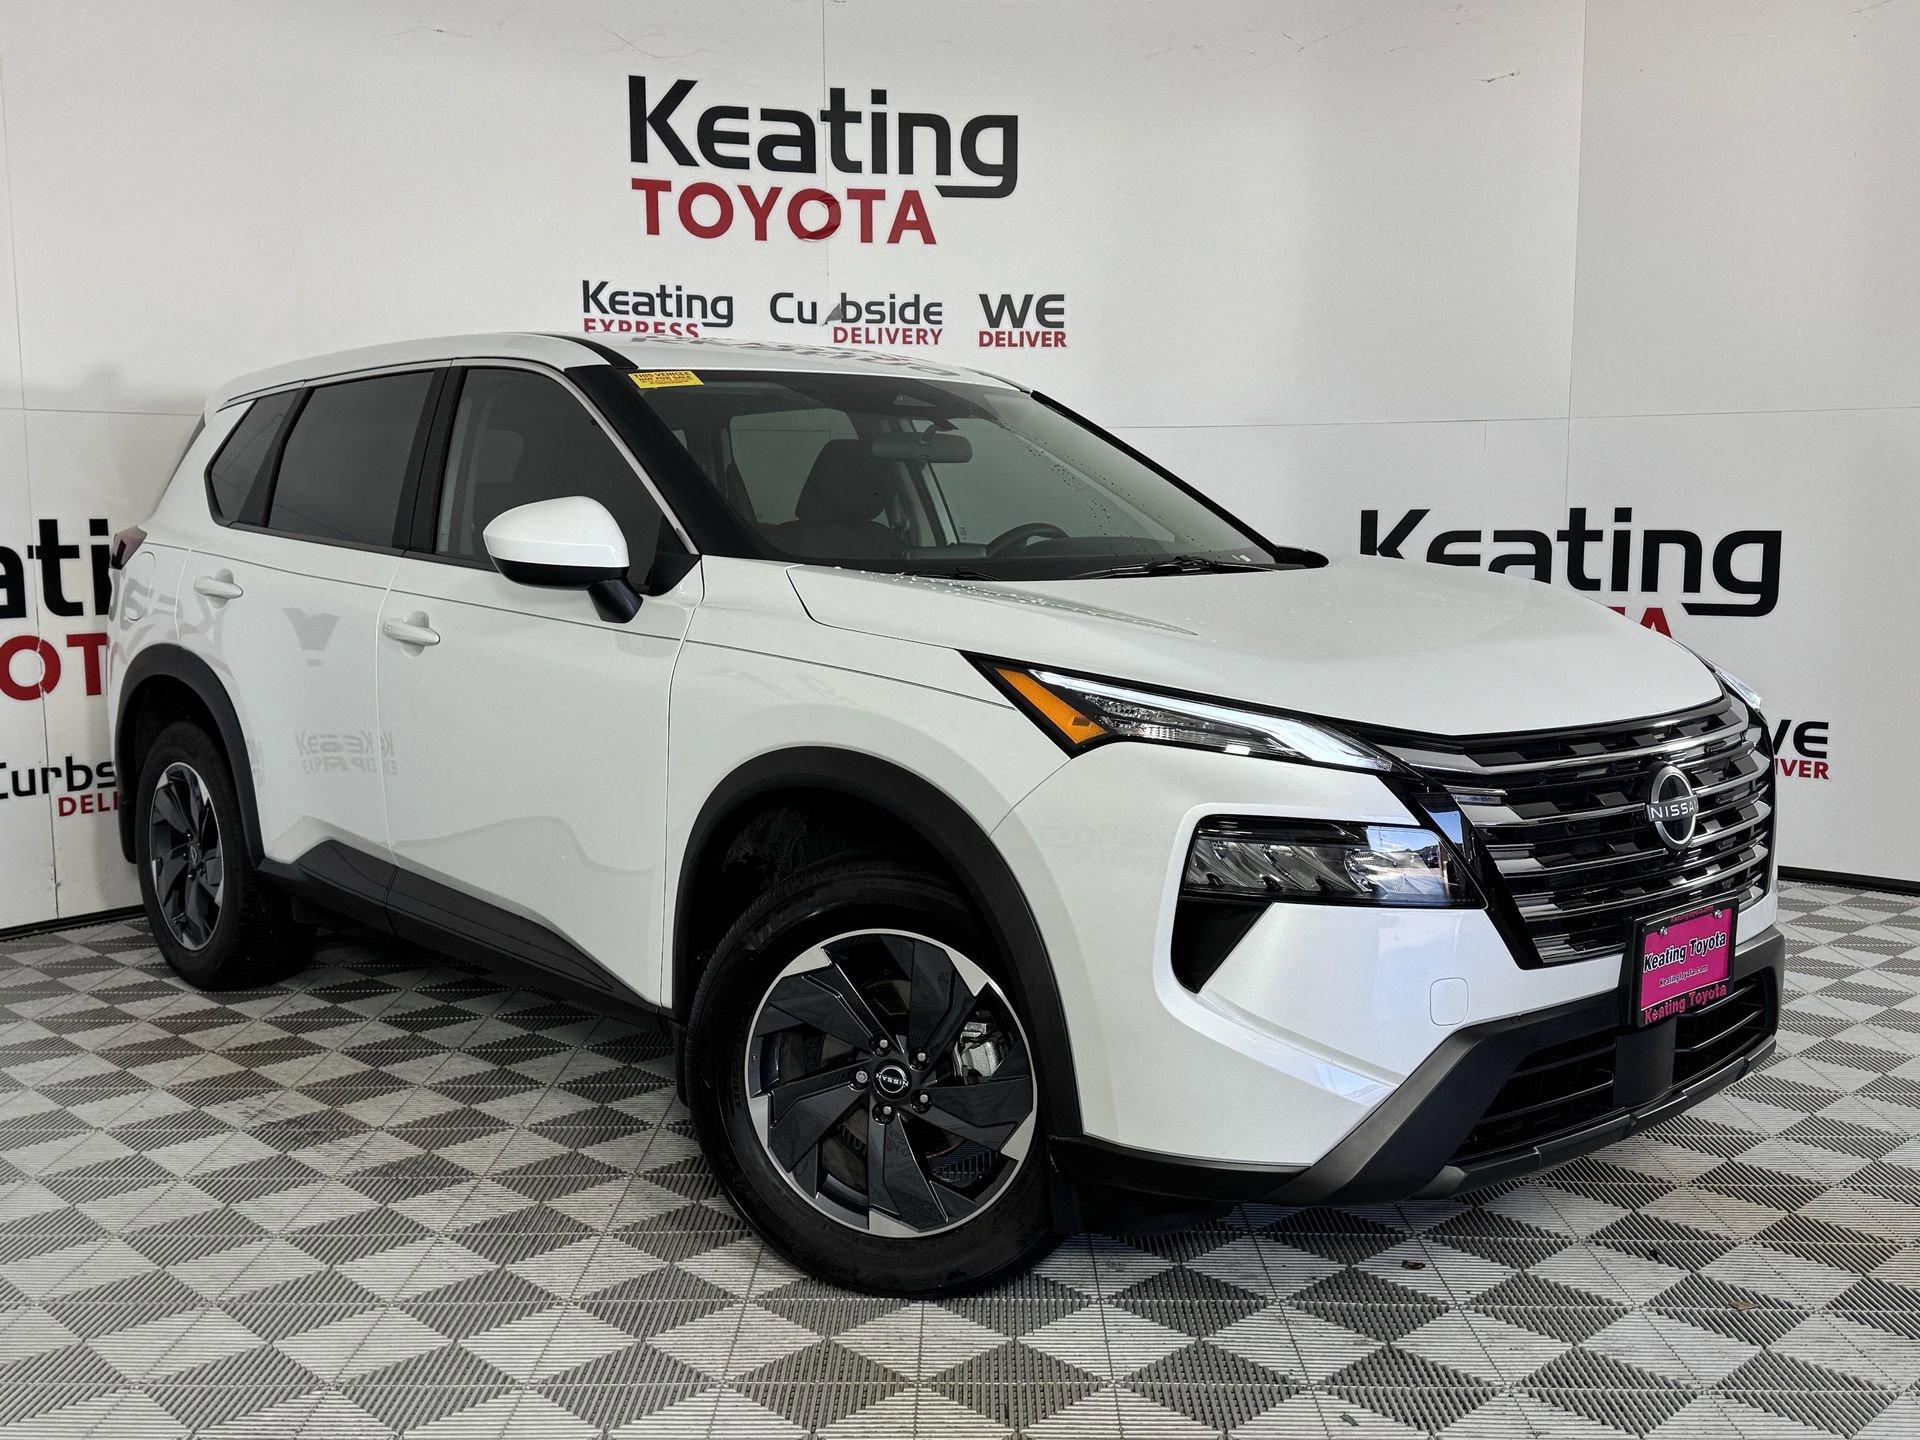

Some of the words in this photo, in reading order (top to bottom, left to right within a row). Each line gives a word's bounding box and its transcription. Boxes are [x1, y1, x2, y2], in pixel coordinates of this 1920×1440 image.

[628, 74, 1019, 199] Keating
[631, 177, 937, 245] TOYOTA
[582, 279, 734, 328] Keating
[769, 292, 943, 325] Cubside
[978, 293, 1065, 329] WE
[833, 326, 943, 346] DELIVERY
[978, 330, 1067, 348] DELIVER
[0, 755, 116, 800] urbs
[58, 791, 119, 817] DELI
[1643, 945, 1687, 973] Keating
[1689, 931, 1726, 956] Toyota
[1645, 999, 1686, 1024] Keating
[1689, 983, 1727, 1006] Toyota
